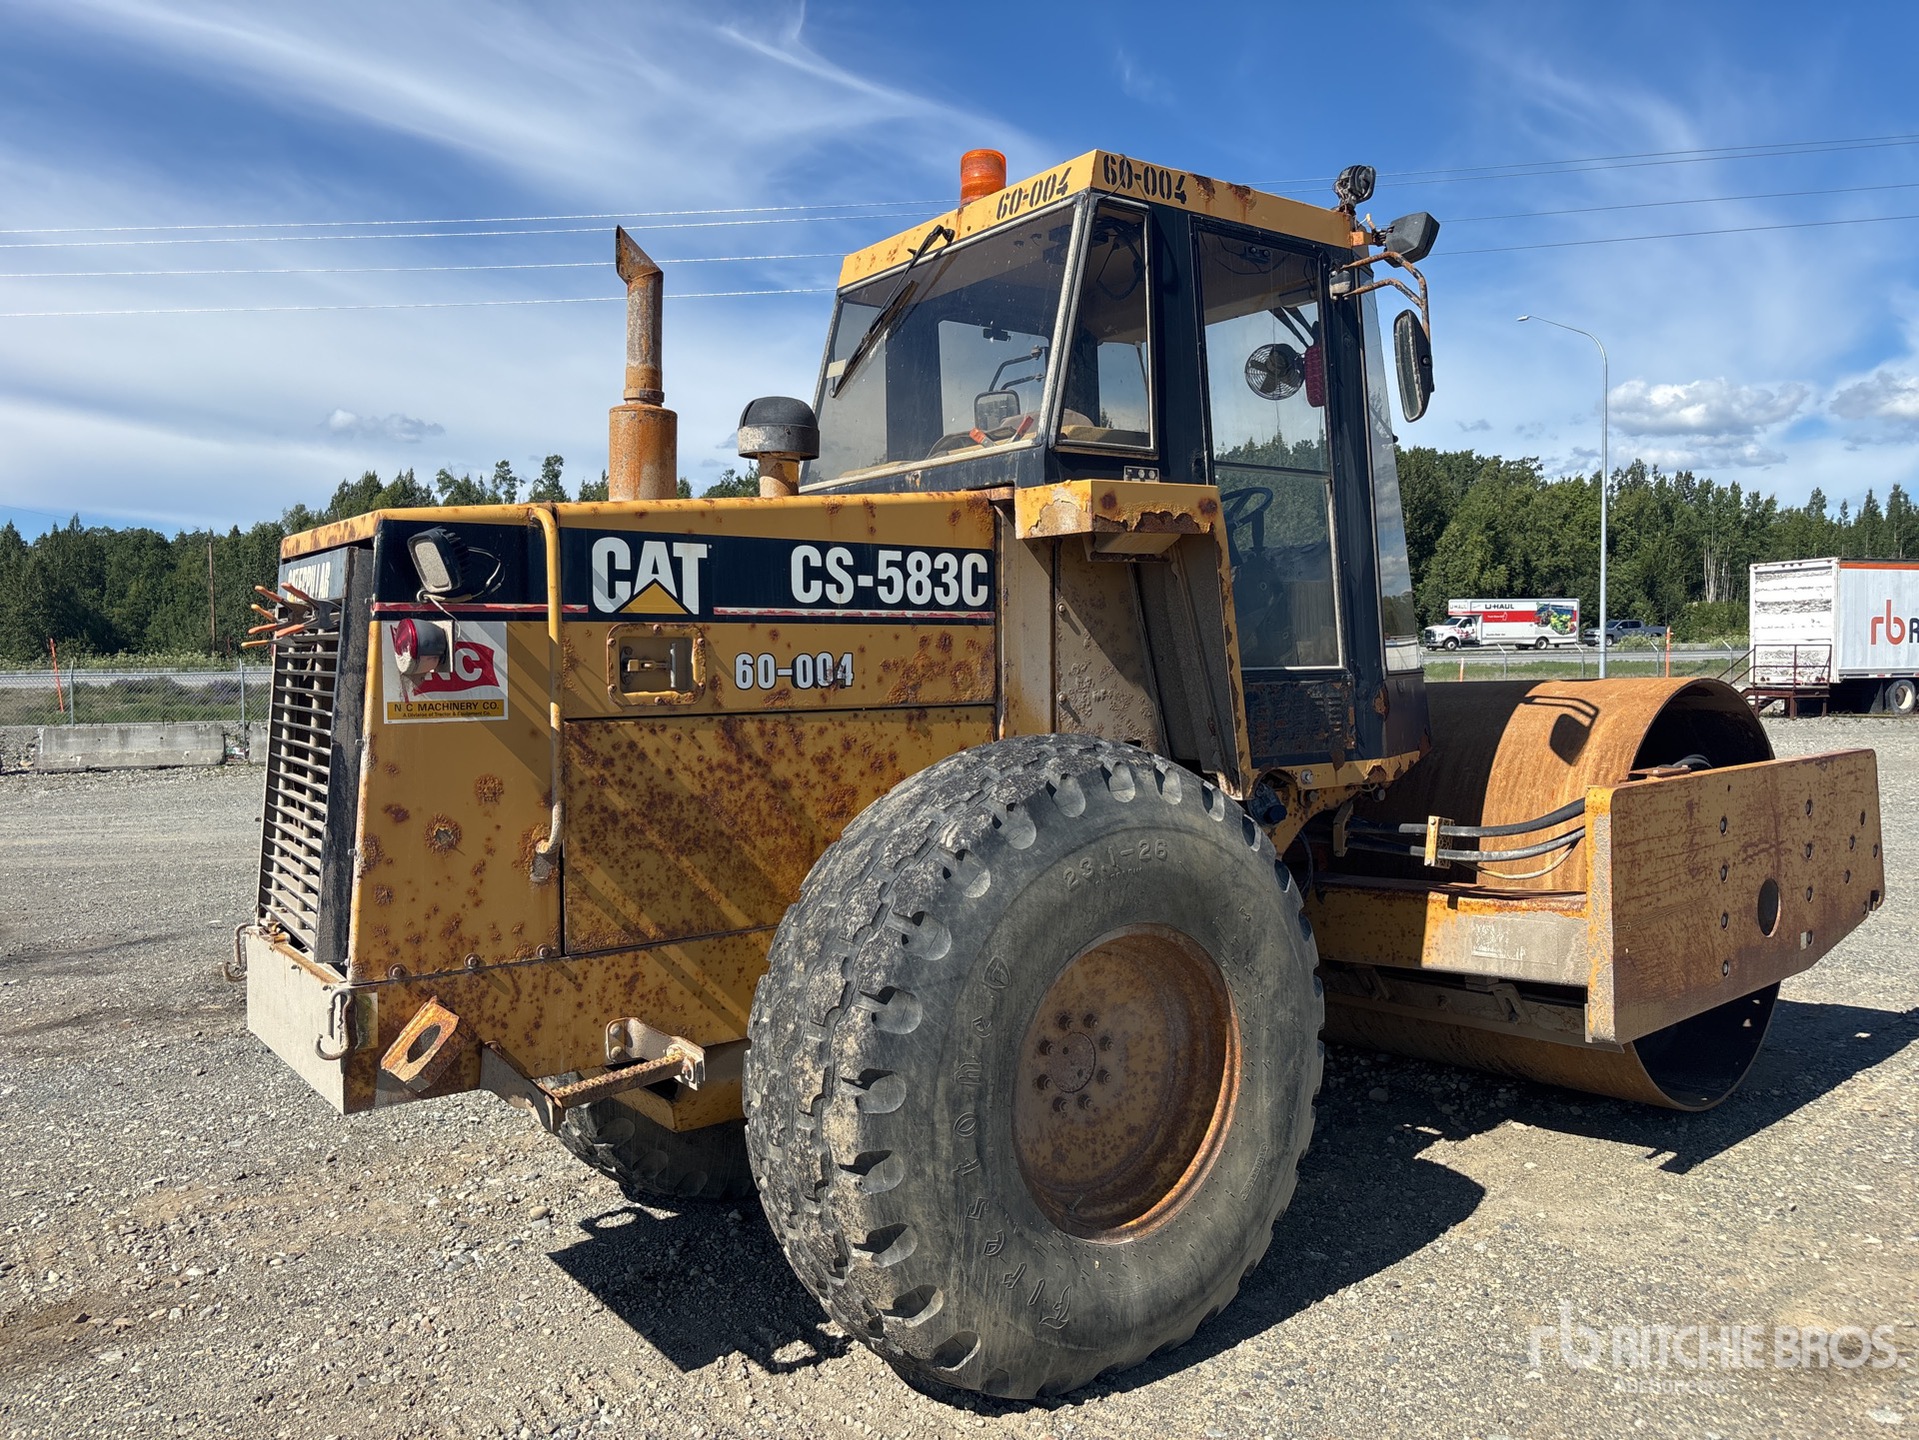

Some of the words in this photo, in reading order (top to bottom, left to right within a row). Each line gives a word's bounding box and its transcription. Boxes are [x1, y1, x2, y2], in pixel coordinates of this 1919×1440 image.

[996, 166, 1072, 221] 60-004
[1103, 154, 1187, 205] 60-004
[591, 537, 708, 615] CAT
[790, 544, 989, 606] CS-583C
[1871, 599, 1906, 645] rb
[734, 652, 854, 690] 60-004
[394, 703, 402, 712] N
[406, 703, 413, 712] C
[418, 702, 479, 712] MACHINERY
[482, 701, 500, 710] CO.
[1062, 839, 1168, 892] 23.1-26
